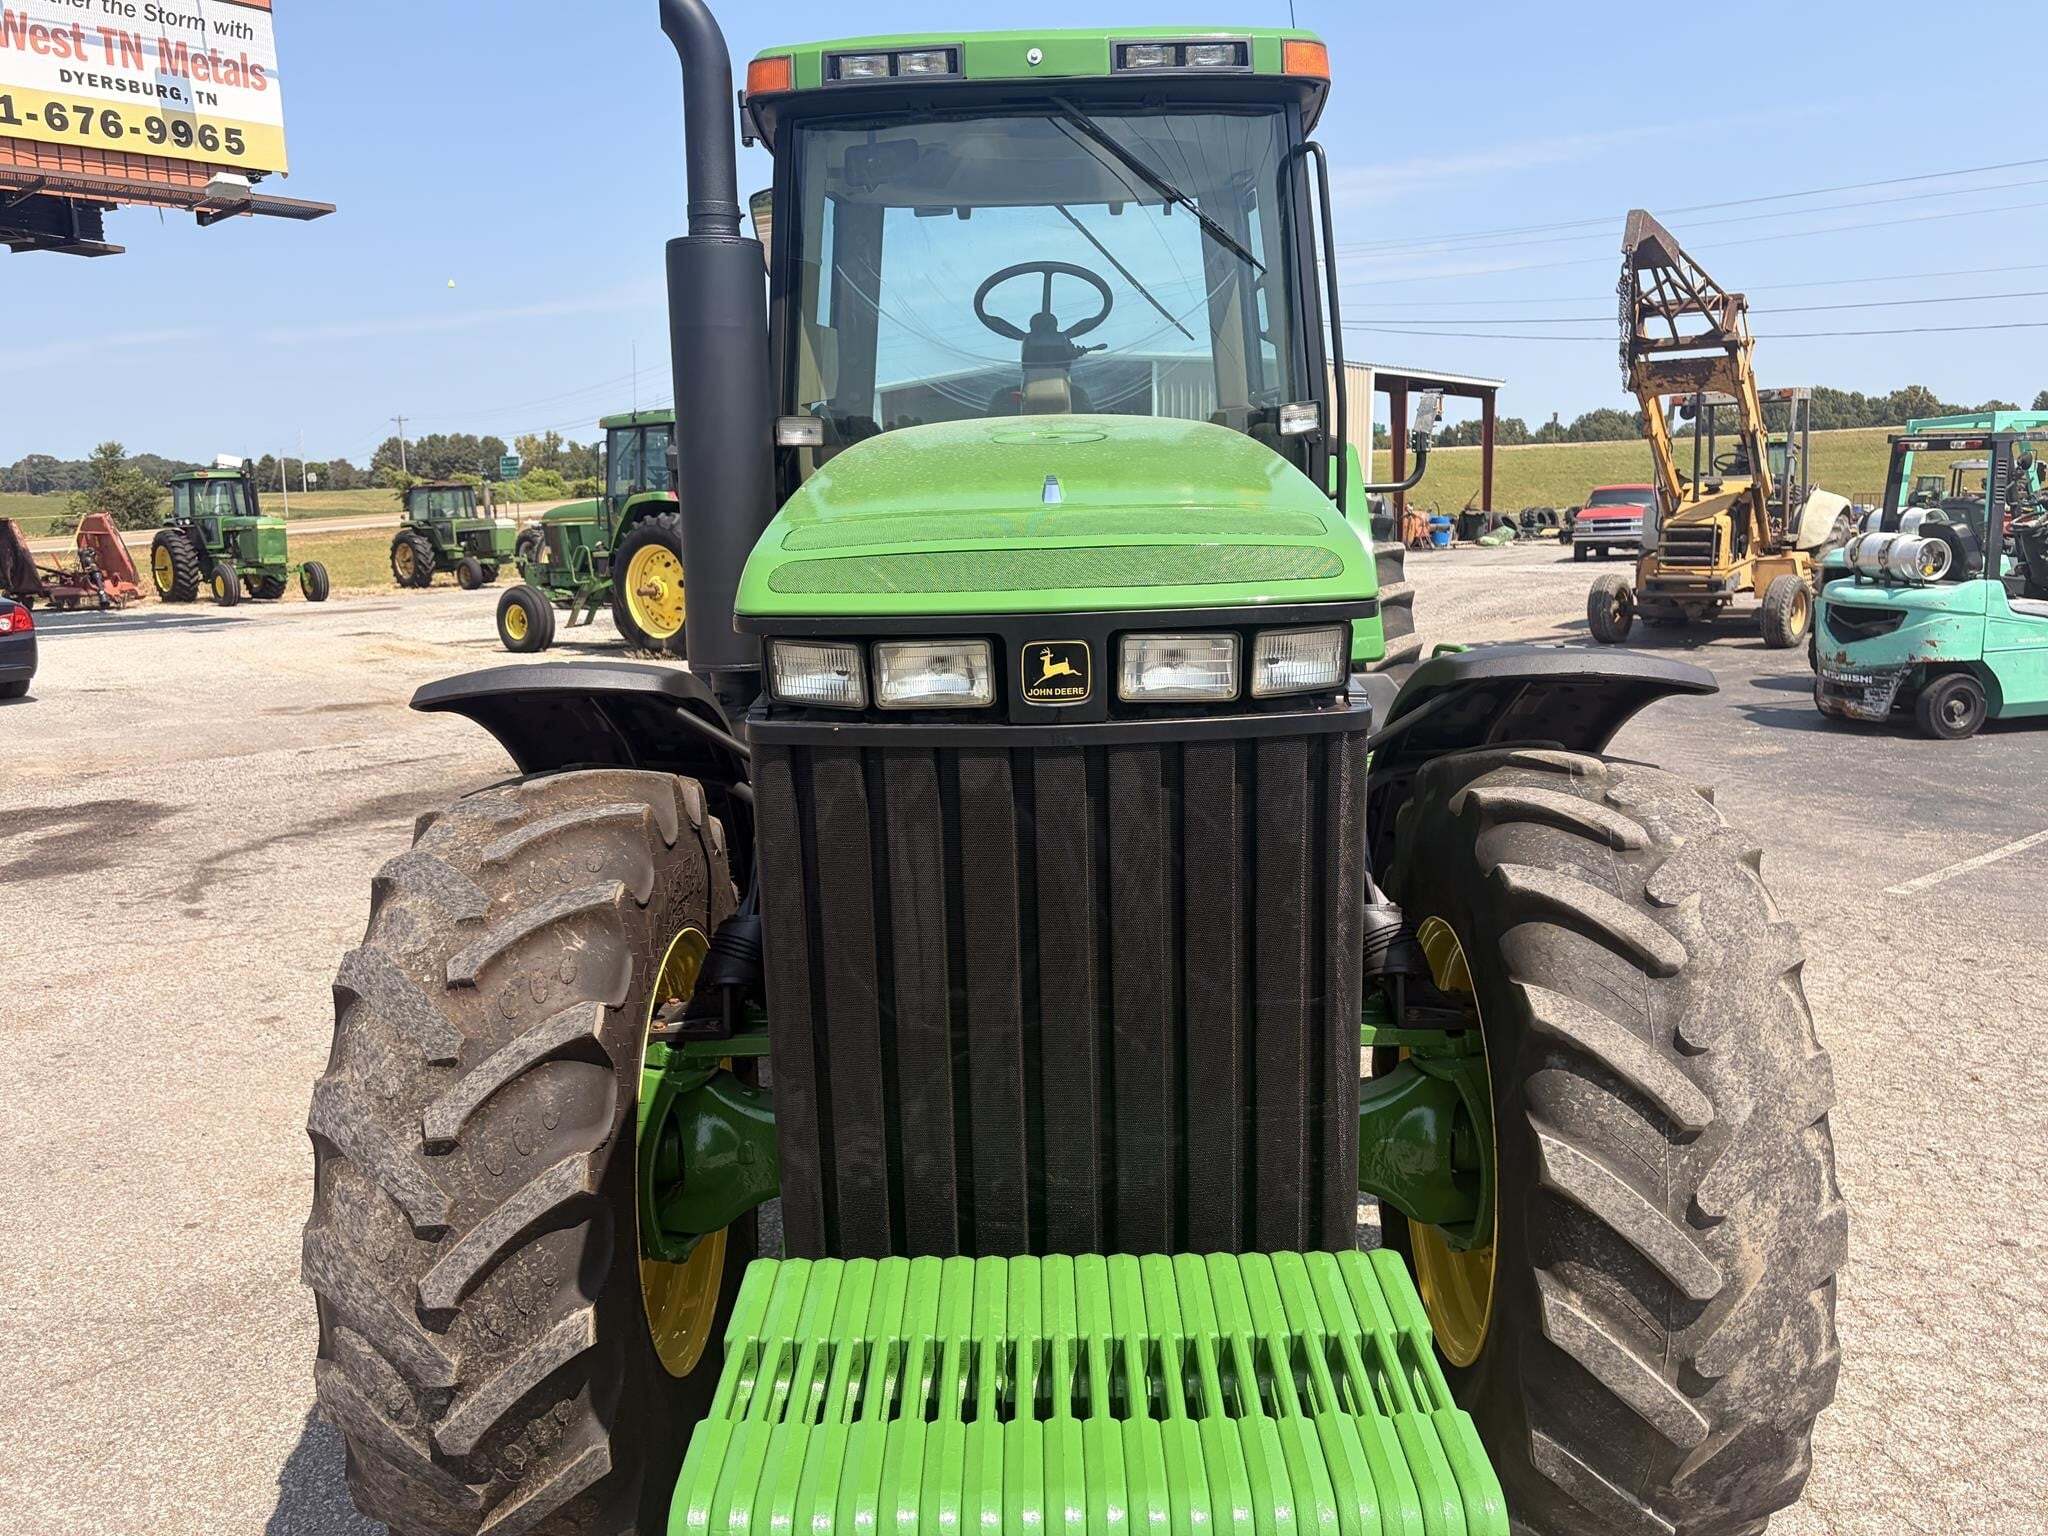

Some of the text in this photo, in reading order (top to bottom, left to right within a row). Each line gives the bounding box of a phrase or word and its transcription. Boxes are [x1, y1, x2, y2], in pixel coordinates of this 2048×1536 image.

[102, 0, 136, 18] the
[144, 3, 206, 31] Storm
[214, 20, 254, 41] with
[0, 8, 268, 91] West TN Metals
[59, 69, 218, 106] DYERSBURG, TN
[0, 94, 246, 156] 1-676-9965
[1028, 687, 1085, 696] JOHN DEERE
